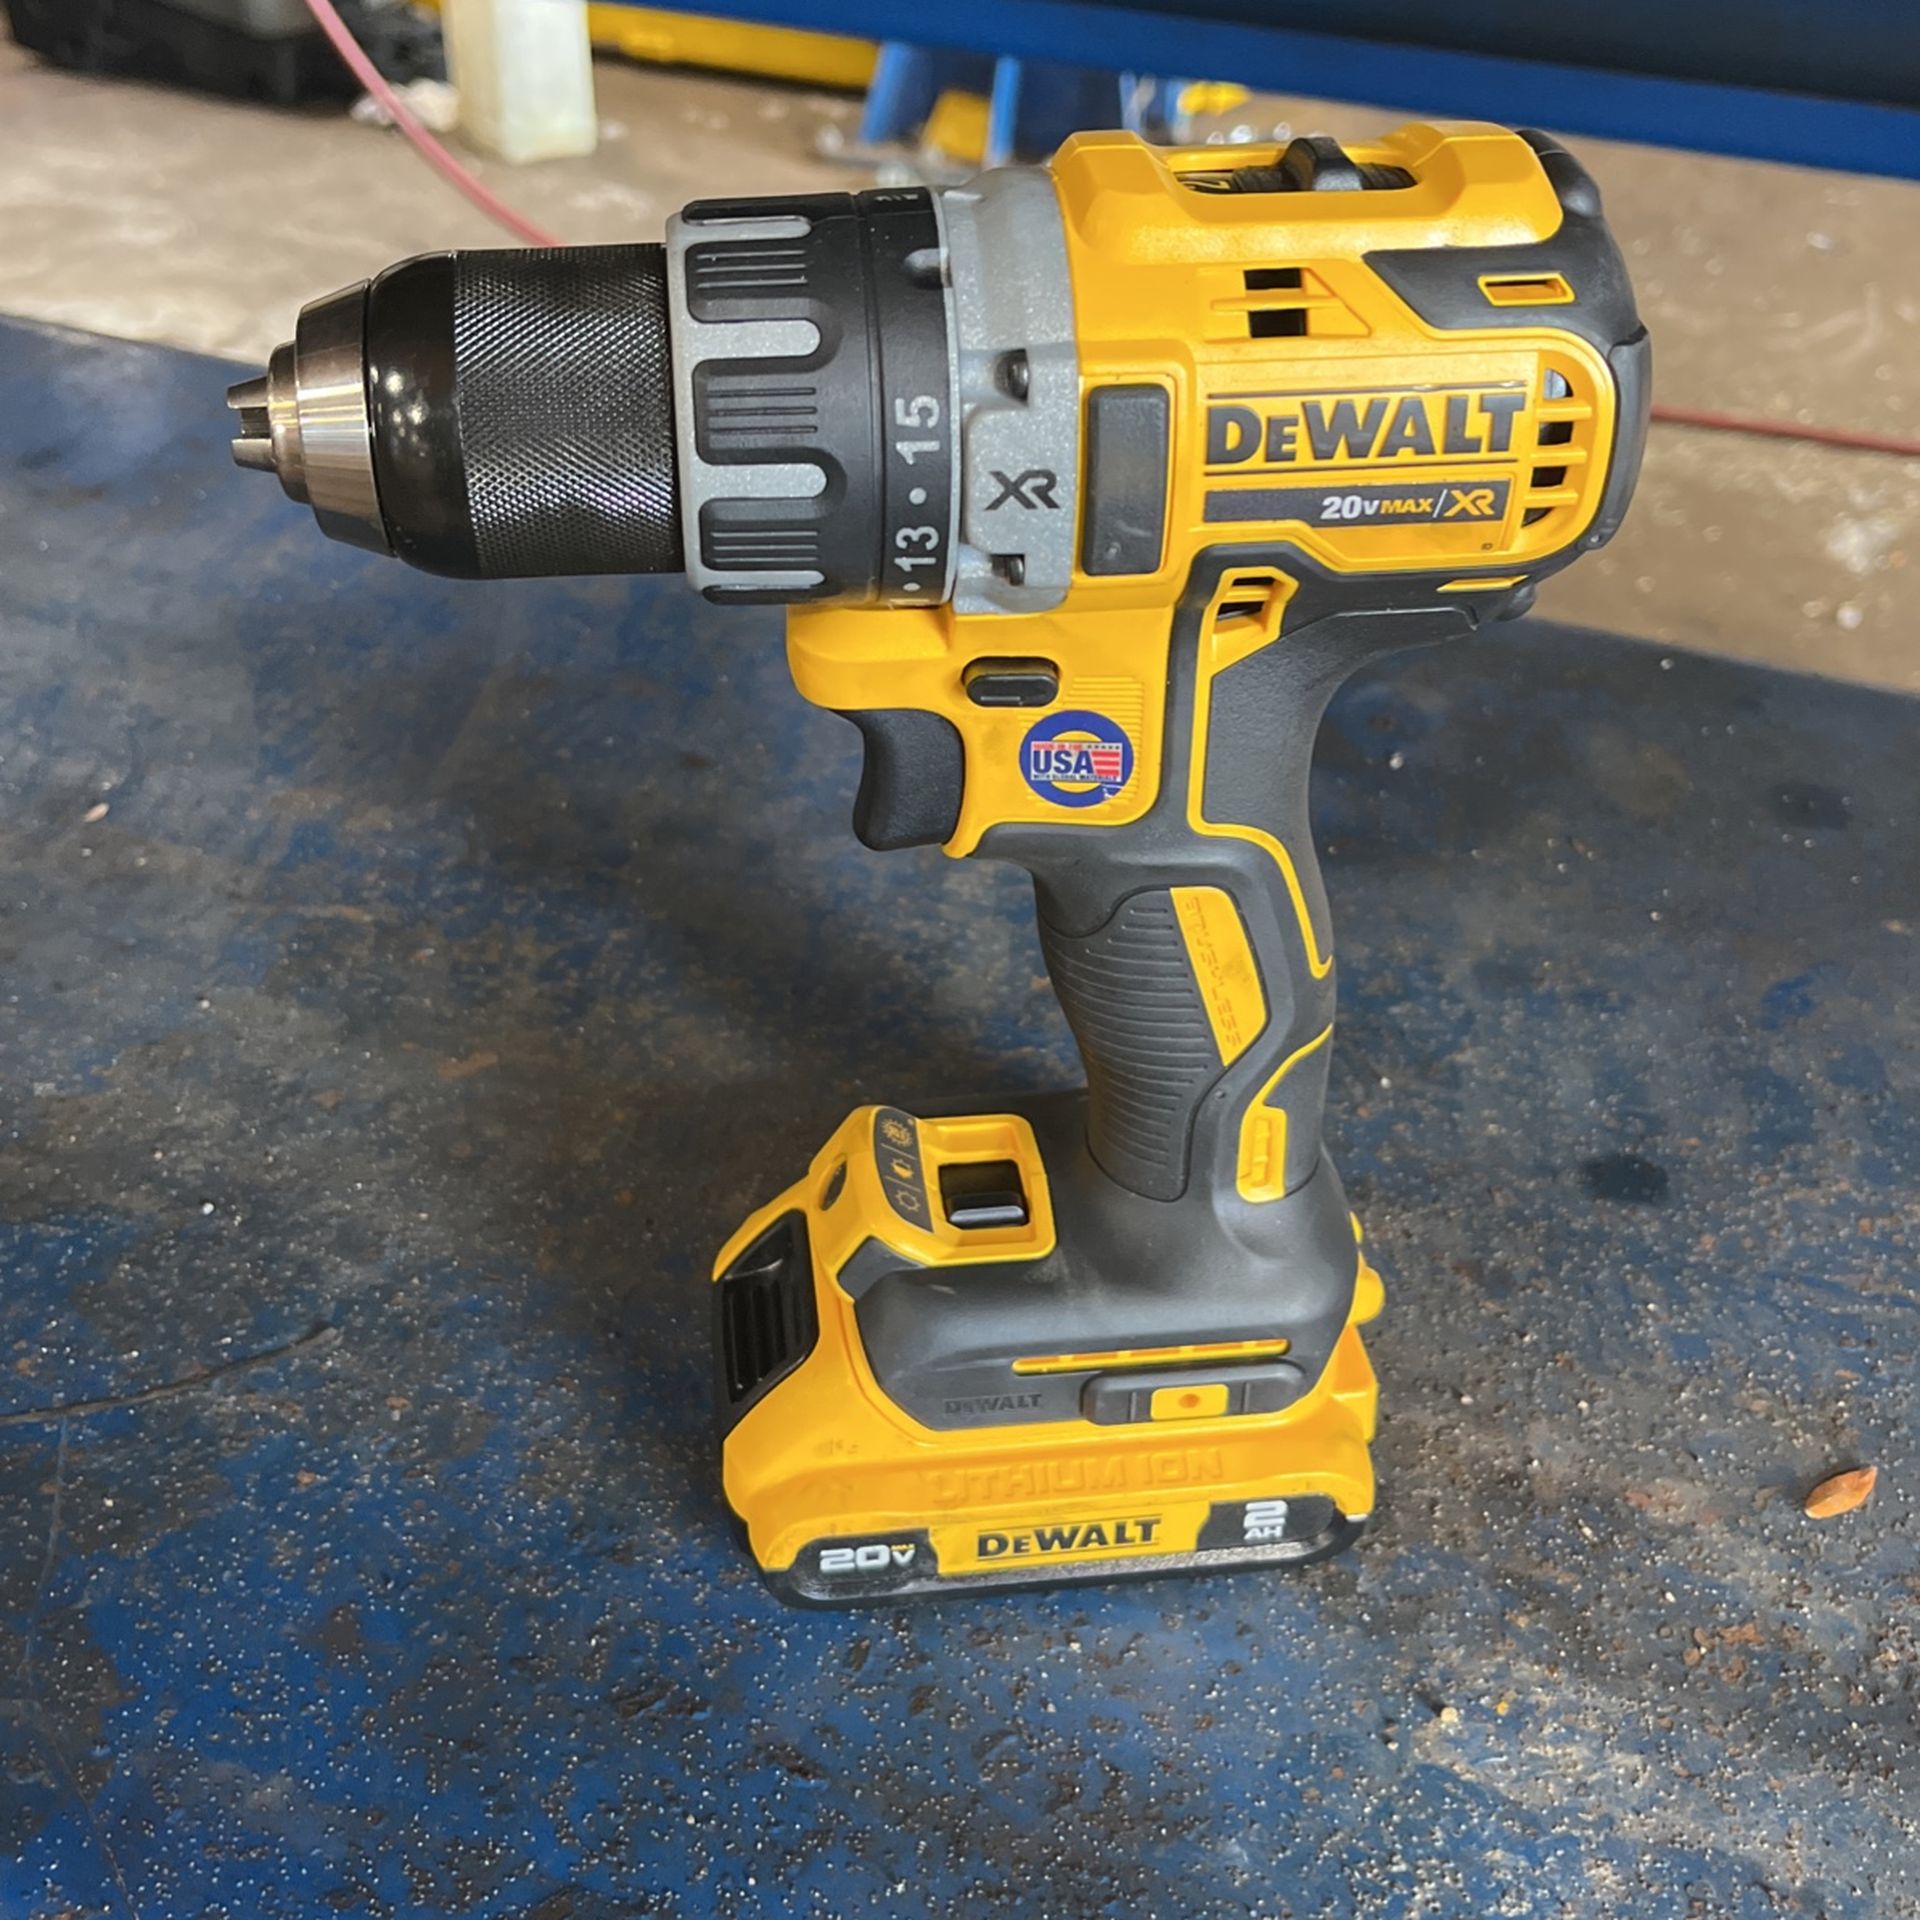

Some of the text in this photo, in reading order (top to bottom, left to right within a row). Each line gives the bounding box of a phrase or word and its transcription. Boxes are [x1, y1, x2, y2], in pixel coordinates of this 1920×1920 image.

[894, 395, 940, 466] 15
[984, 469, 1060, 511] XR
[893, 526, 939, 572] 13
[1033, 750, 1095, 774] USA
[1142, 1447, 1224, 1487] ION
[1243, 1500, 1289, 1528] 2
